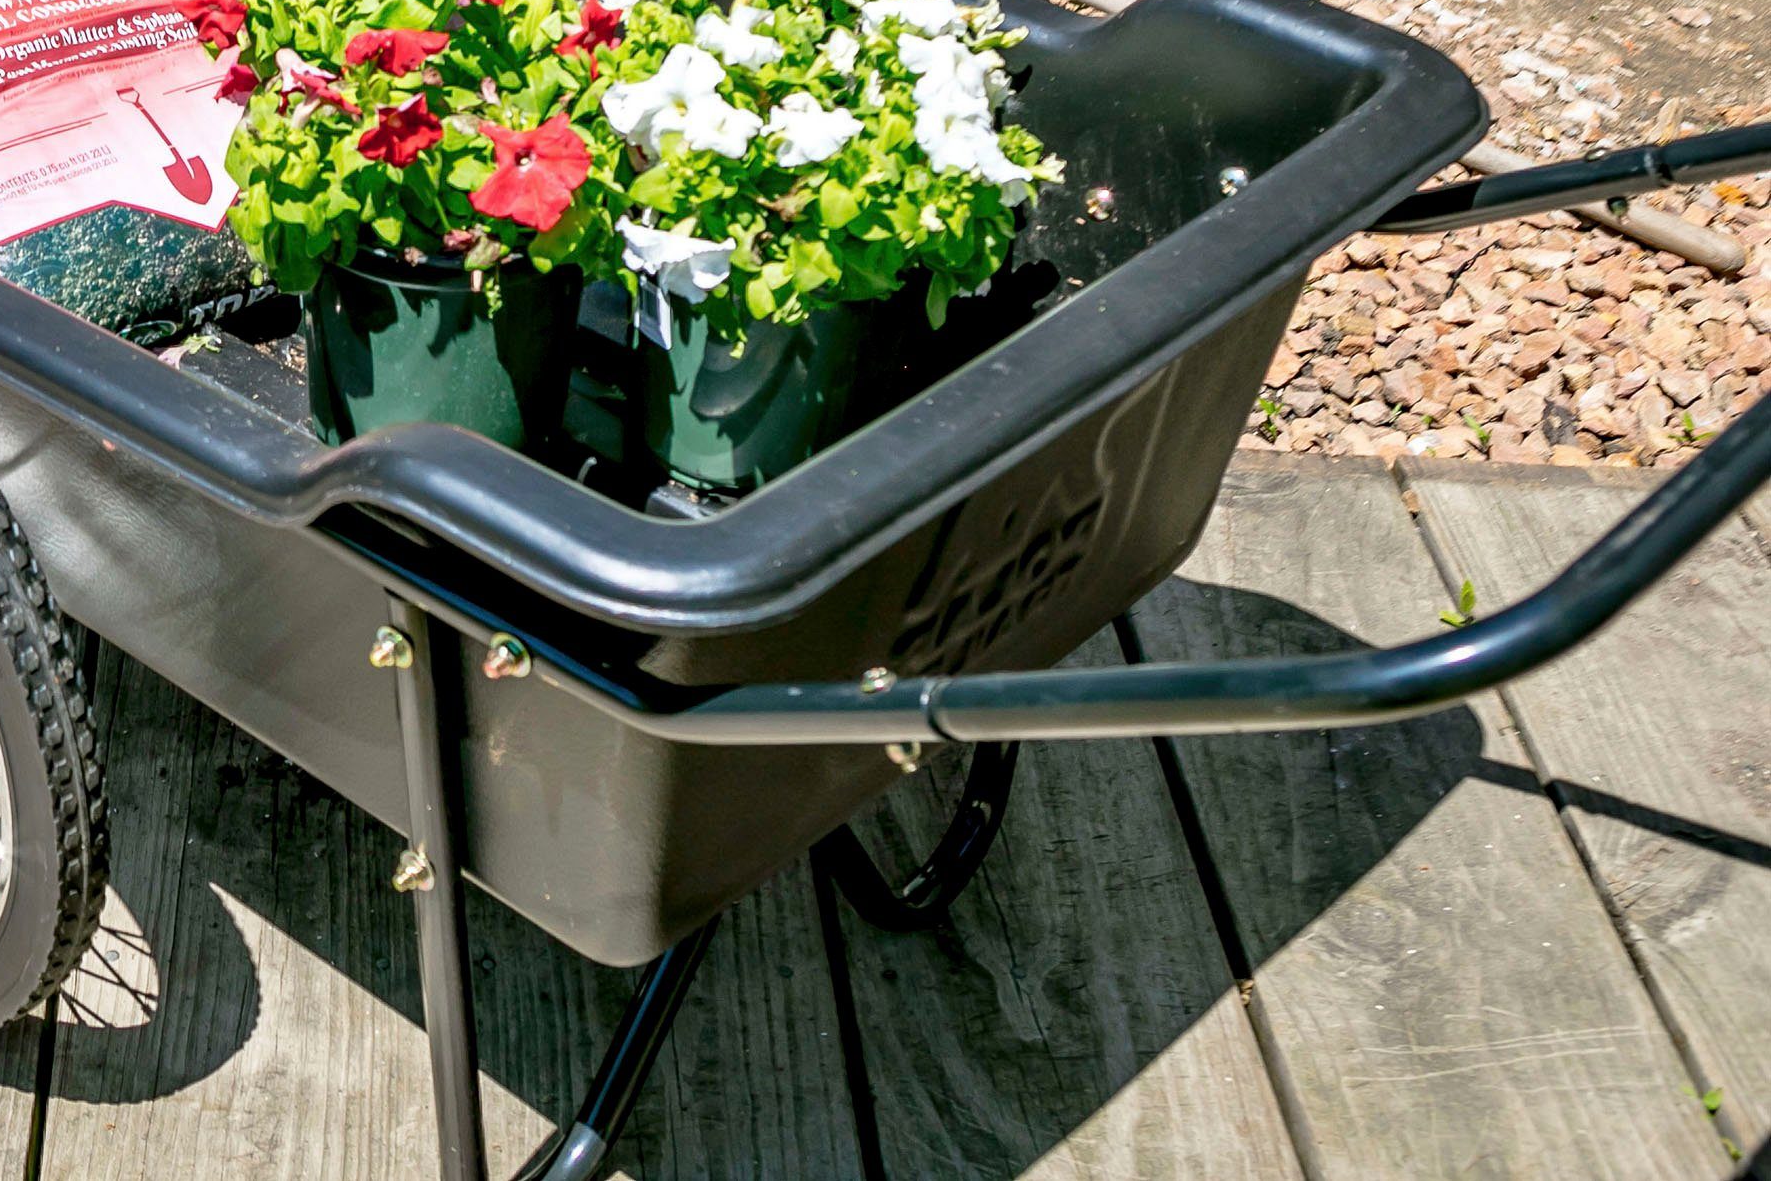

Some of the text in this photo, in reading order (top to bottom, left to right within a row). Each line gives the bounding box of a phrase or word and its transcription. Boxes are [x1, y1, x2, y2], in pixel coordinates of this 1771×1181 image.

[59, 24, 115, 47] Matter
[116, 17, 135, 36] &
[164, 21, 199, 42] Soil
